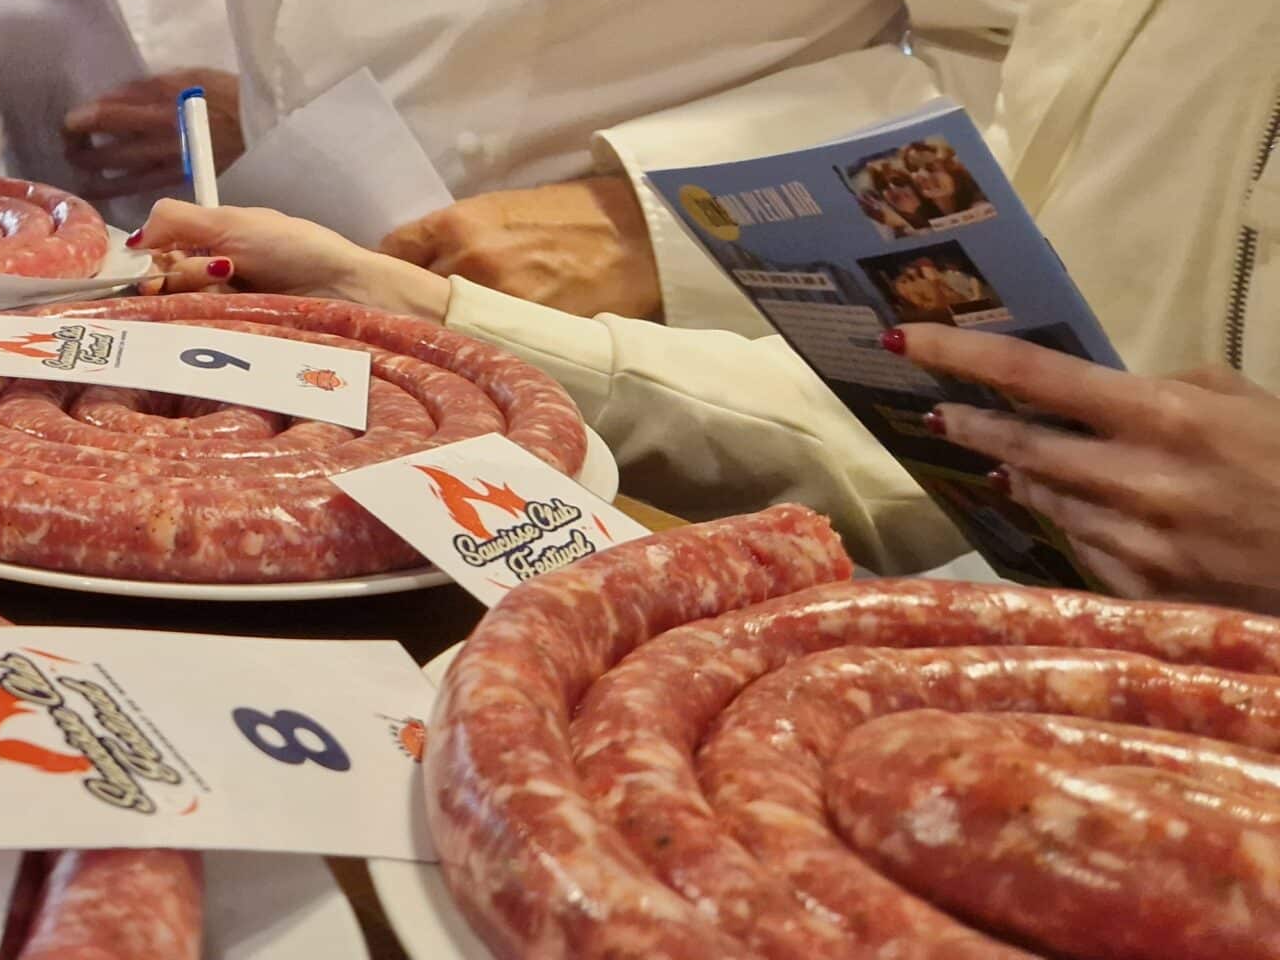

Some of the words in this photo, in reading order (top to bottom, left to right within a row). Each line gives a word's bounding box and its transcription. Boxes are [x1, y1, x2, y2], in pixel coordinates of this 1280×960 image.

[179, 347, 251, 372] 9
[453, 523, 543, 567] Saucisse
[526, 497, 582, 532] Club
[506, 529, 596, 581] Festival
[232, 707, 351, 772] 8
